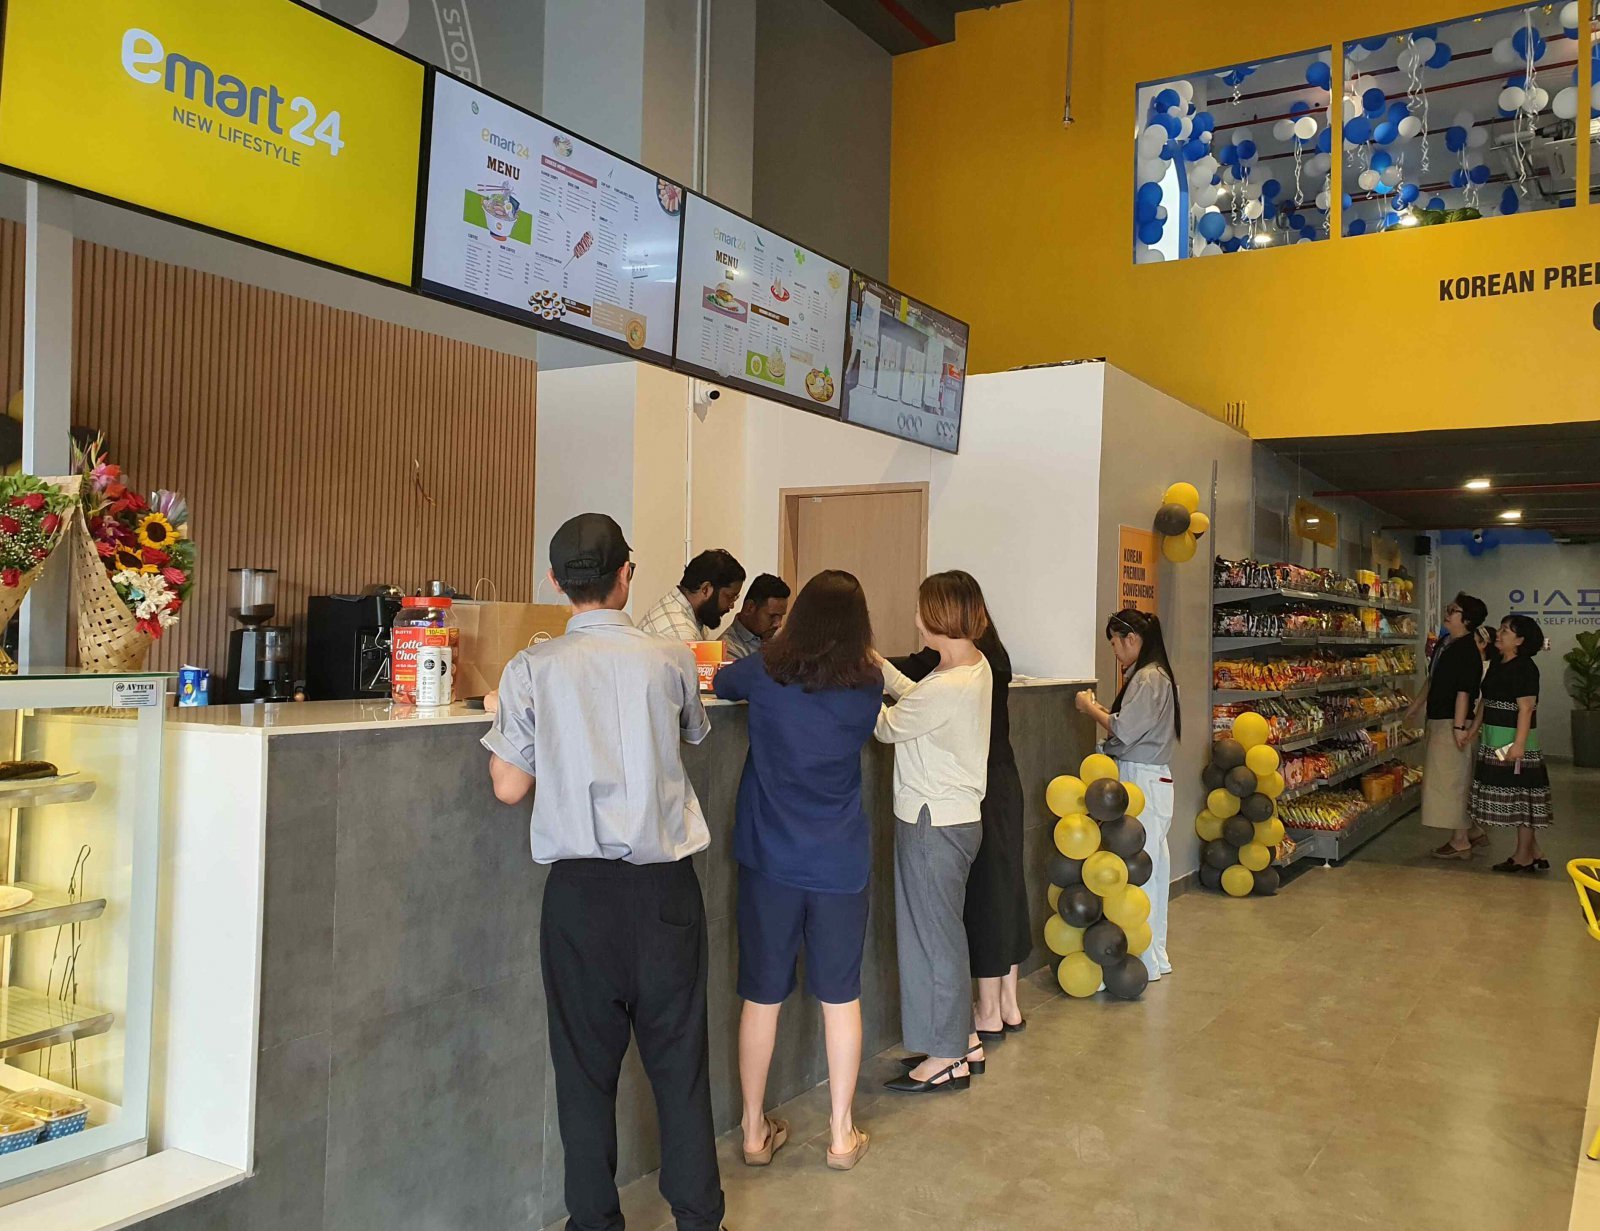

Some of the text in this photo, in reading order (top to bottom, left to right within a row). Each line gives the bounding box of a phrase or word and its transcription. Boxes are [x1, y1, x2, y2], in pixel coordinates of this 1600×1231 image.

[121, 28, 345, 156] emart24
[172, 105, 302, 167] NEW LIFESTYLE
[481, 127, 530, 160] emart24
[487, 155, 520, 181] MENU
[713, 226, 746, 251] emart24
[715, 250, 739, 269] MENU
[1439, 269, 1535, 301] KOREAN
[1123, 548, 1142, 564] KOREAN
[1123, 566, 1145, 582] PREMIUM
[1122, 582, 1154, 599] CONVENIENCE
[1543, 617, 1566, 625] SELF
[396, 639, 422, 649] Lotte
